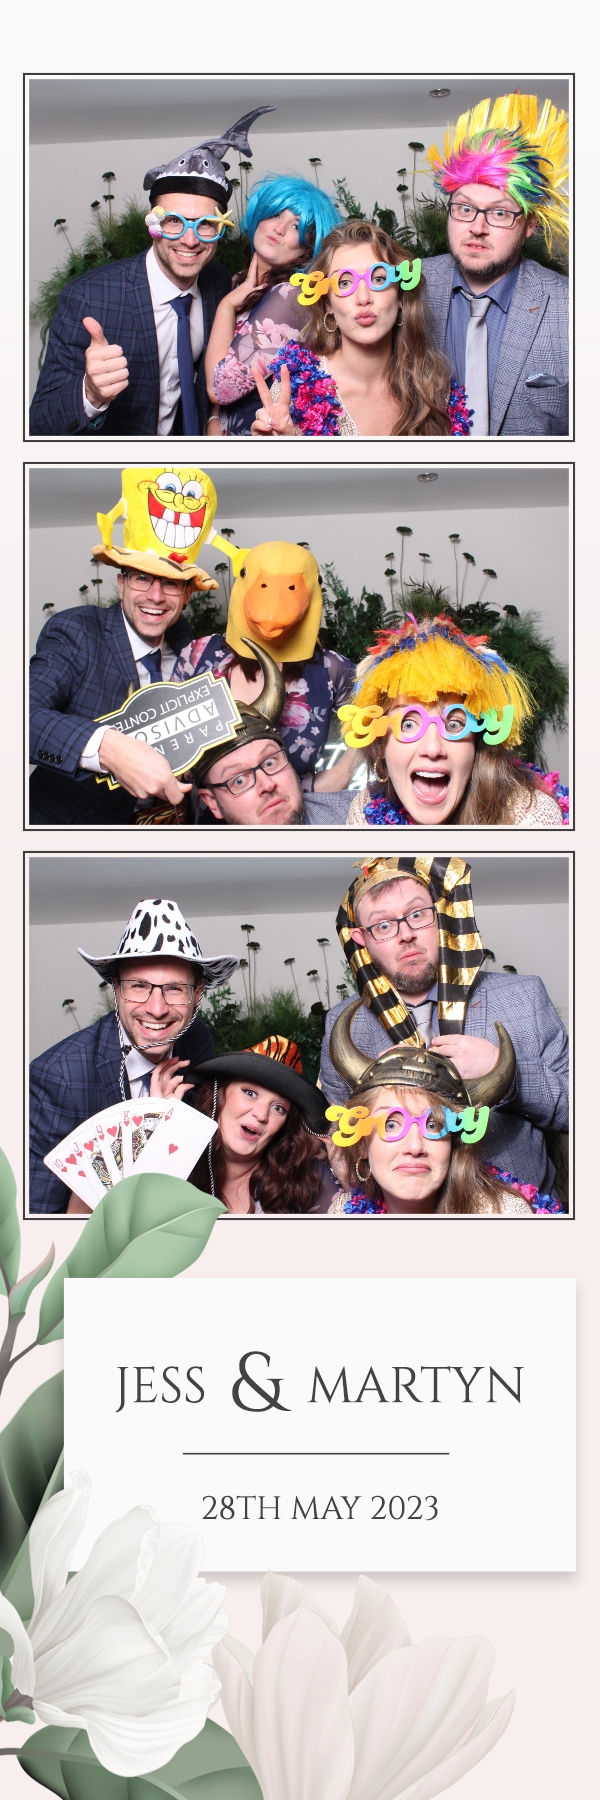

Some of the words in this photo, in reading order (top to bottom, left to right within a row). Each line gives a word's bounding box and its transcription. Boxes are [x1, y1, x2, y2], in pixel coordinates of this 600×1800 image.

[159, 686, 210, 715] EXPLICIT
[112, 708, 157, 733] CONTE
[134, 700, 216, 743] ADVISO
[154, 719, 224, 755] PAREN
[123, 1110, 130, 1121] K
[166, 1107, 174, 1116] A
[95, 1124, 103, 1134] Q
[72, 1142, 80, 1153] J
[52, 1158, 64, 1170] 10
